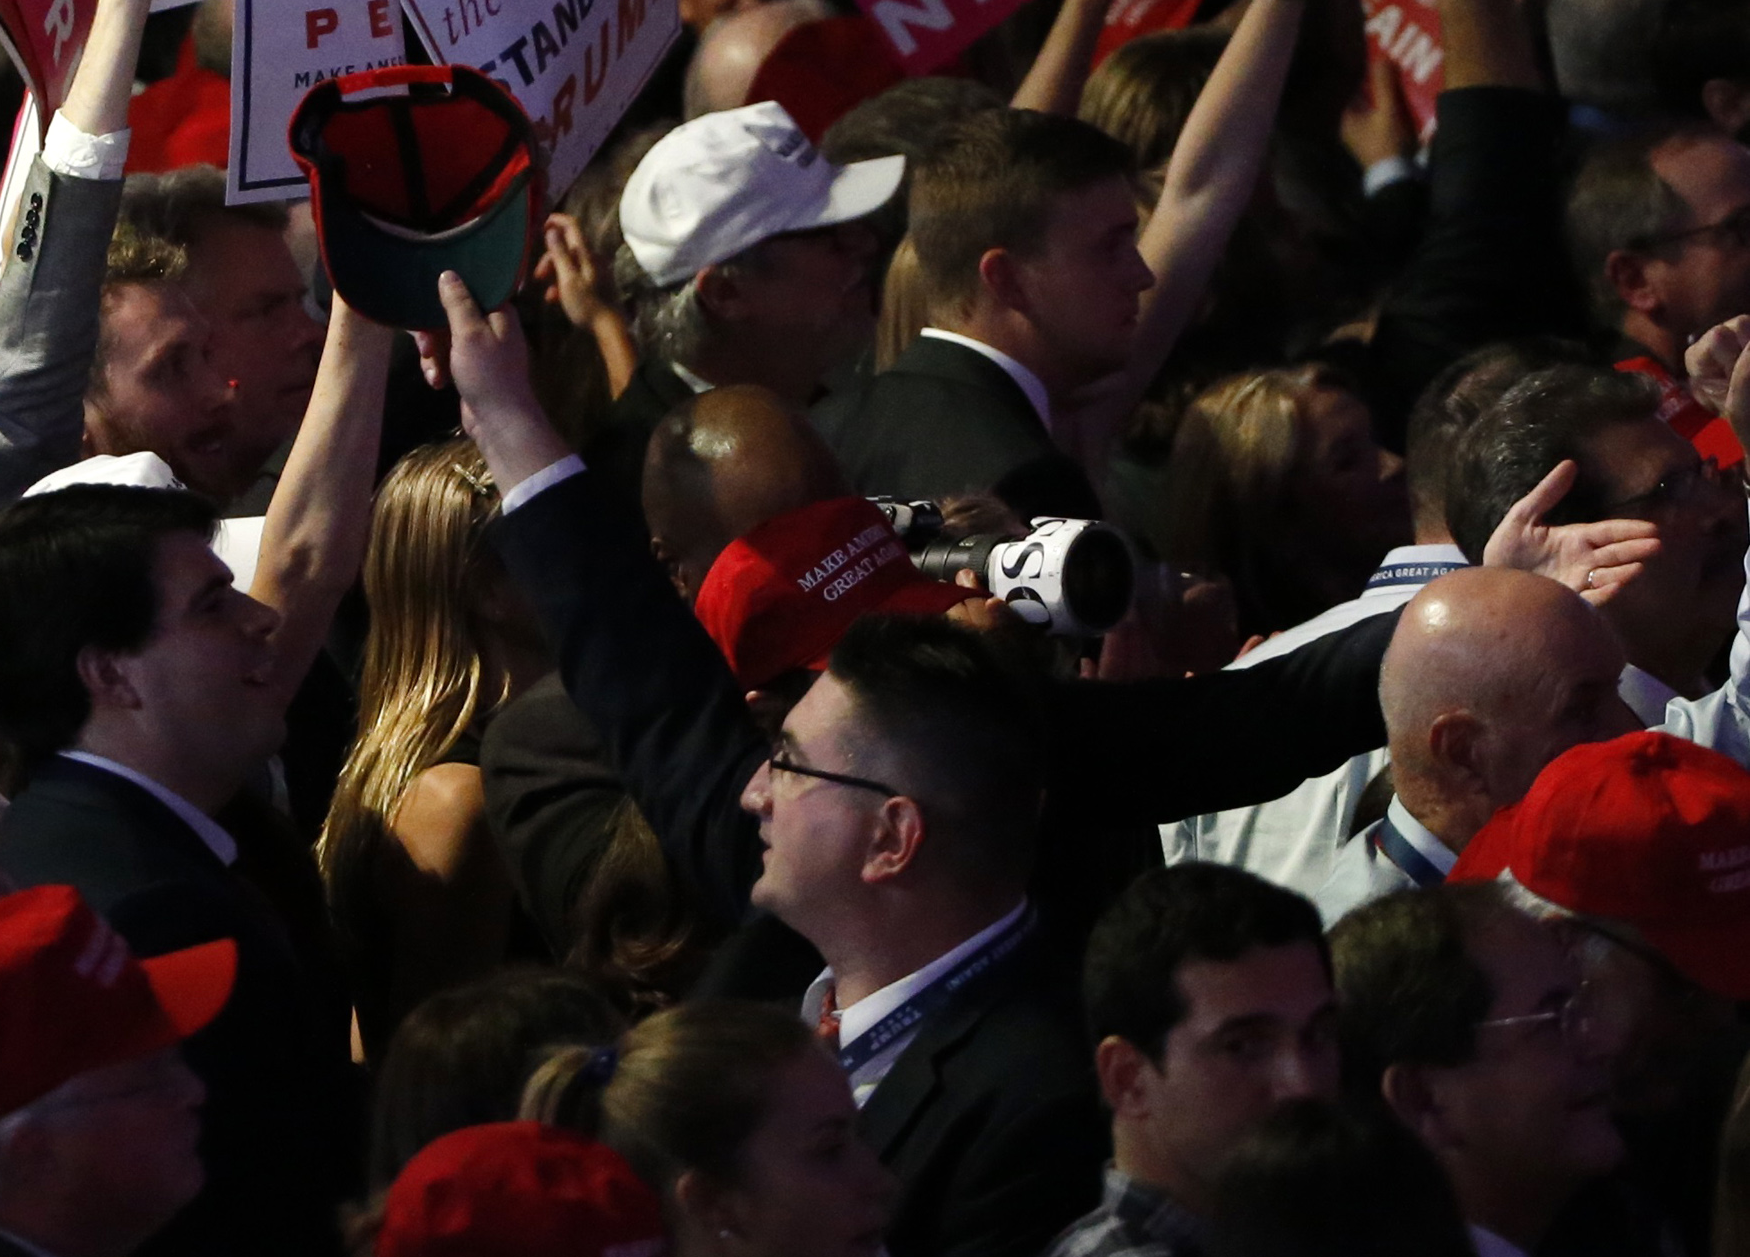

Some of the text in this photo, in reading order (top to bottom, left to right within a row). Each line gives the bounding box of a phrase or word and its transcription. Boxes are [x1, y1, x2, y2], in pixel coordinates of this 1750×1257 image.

[796, 548, 849, 593] MAKE
[822, 558, 876, 602] GREAT
[1395, 567, 1430, 578] GREAT
